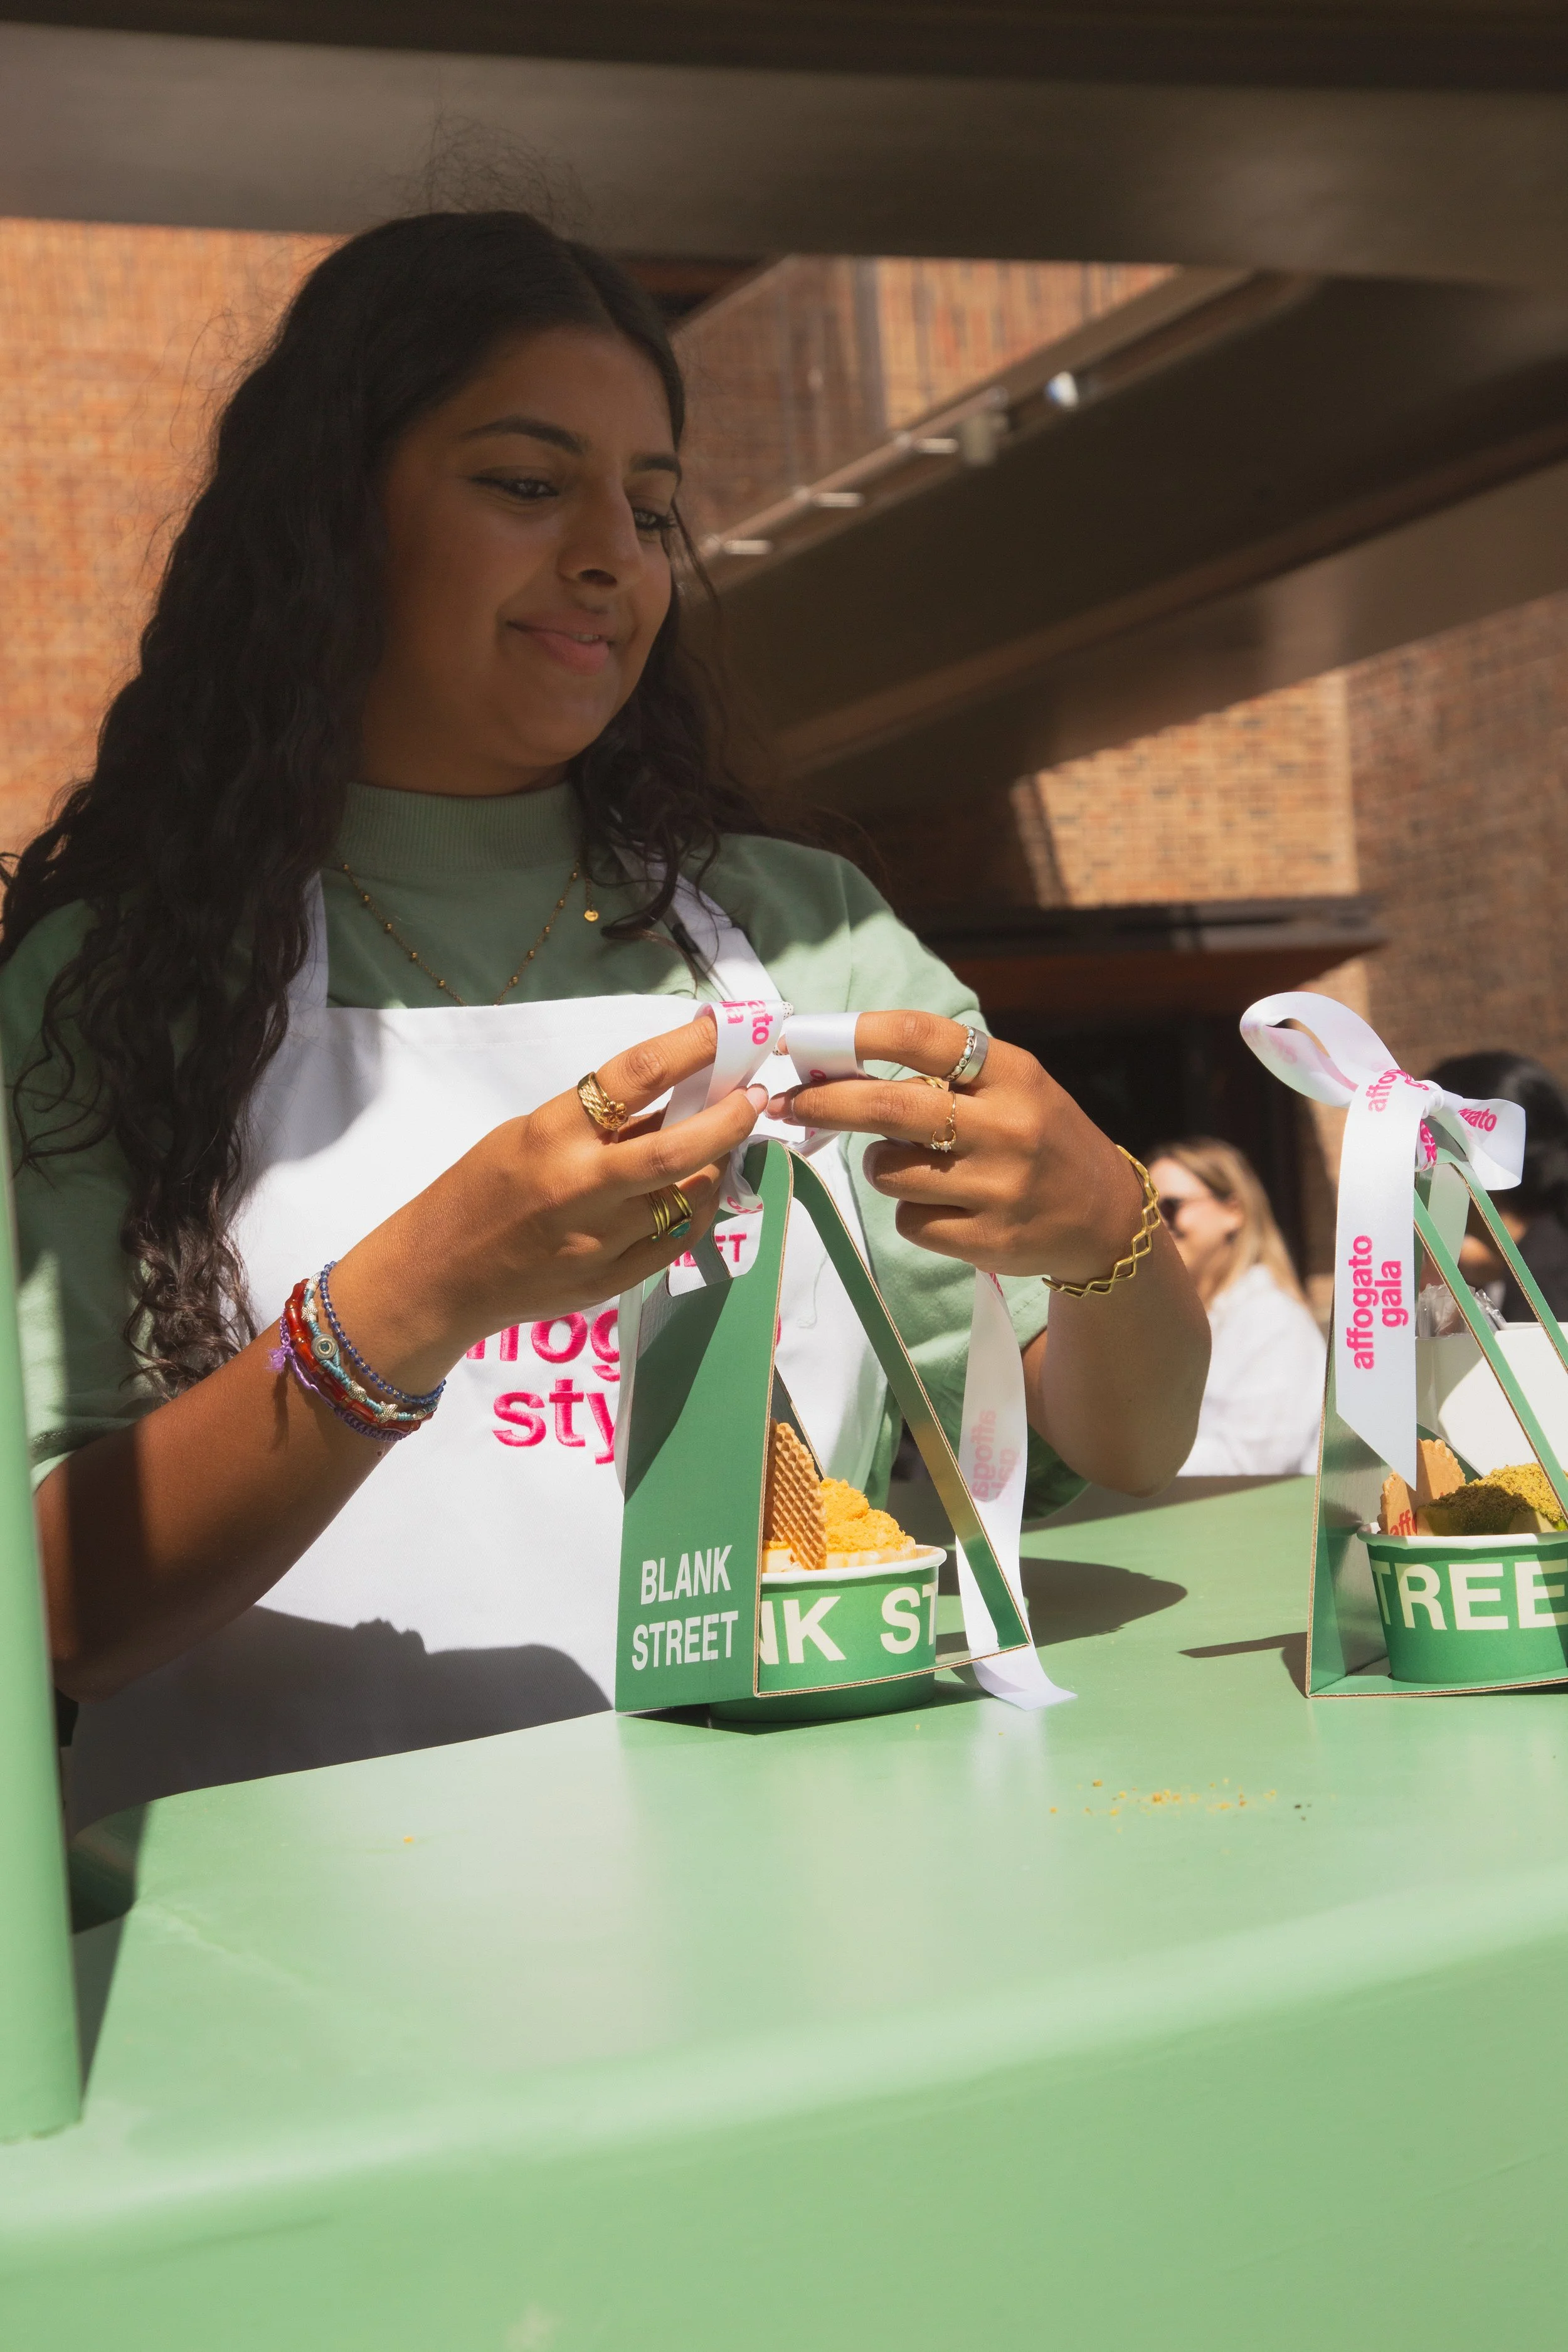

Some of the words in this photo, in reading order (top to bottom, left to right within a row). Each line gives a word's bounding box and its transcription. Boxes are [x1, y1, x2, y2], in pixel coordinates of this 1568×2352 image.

[1347, 1235, 1379, 1370] affogato
[1375, 1261, 1409, 1328] gala
[640, 1545, 733, 1605] BLANK
[632, 1610, 738, 1671] STREET
